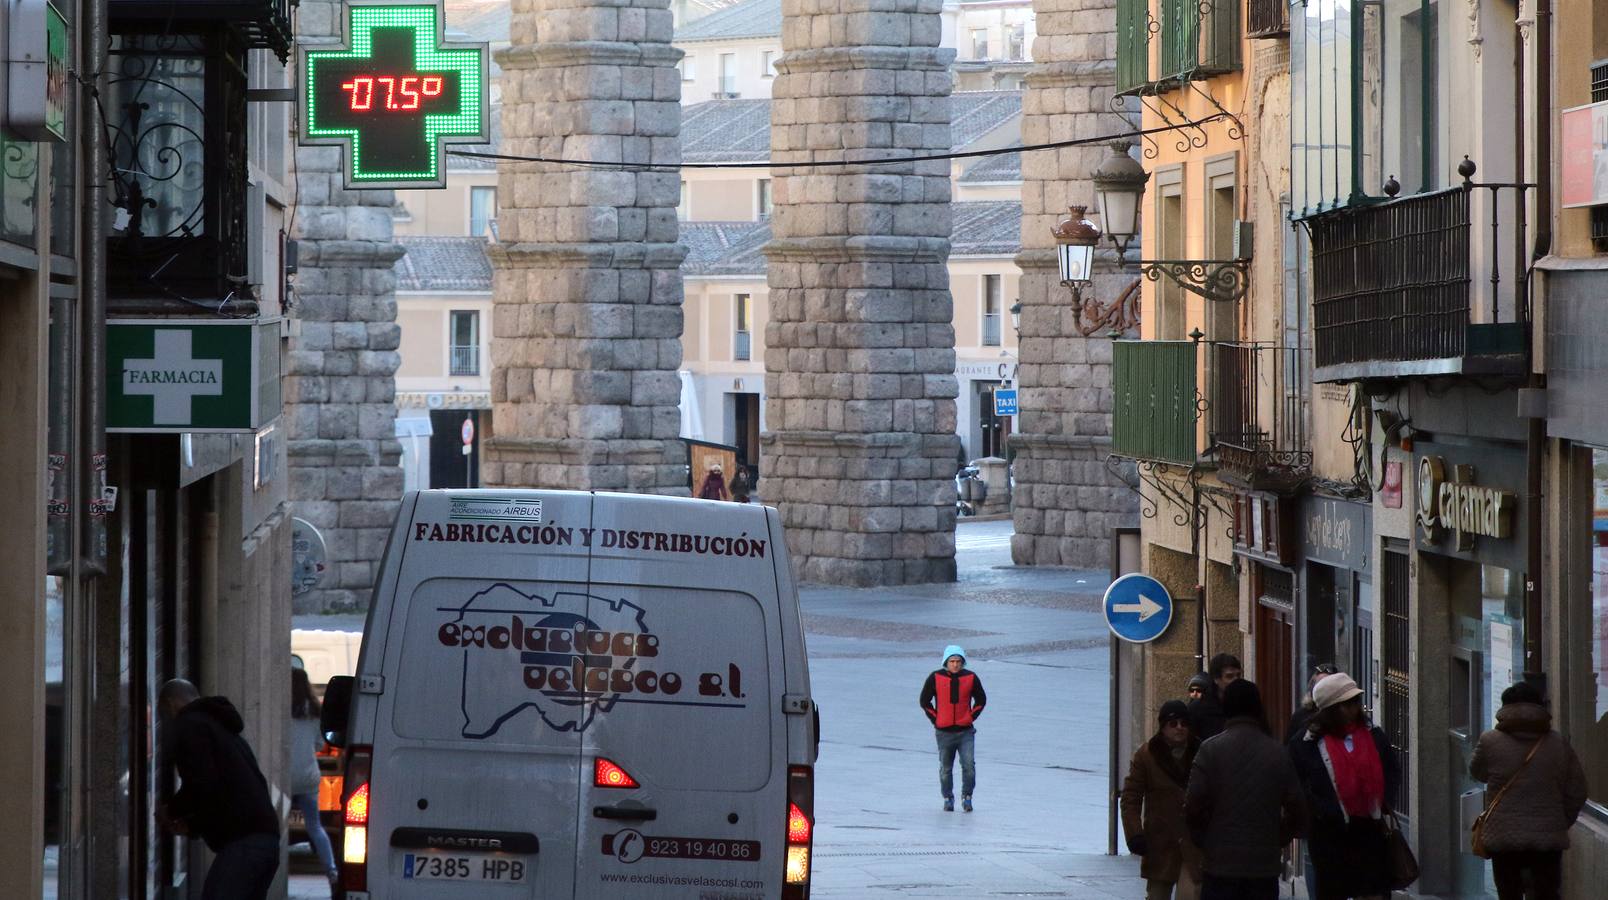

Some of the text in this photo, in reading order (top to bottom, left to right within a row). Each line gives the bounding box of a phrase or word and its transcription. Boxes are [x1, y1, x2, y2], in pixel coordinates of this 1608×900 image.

[129, 370, 217, 384] FARMACIA
[394, 393, 492, 409] WHOPPE
[997, 398, 1016, 407] TAXI
[503, 507, 541, 516] AIRBUS
[1438, 464, 1504, 552] cajamar
[415, 520, 767, 559] FABRICACIÓN Y DISTRIBUCIÓN
[438, 614, 659, 658] exclusivas
[427, 836, 502, 848] MASTER
[650, 839, 750, 858] 923 19 40 86
[415, 856, 524, 881] 7385 HPB
[600, 872, 764, 889] www.exclusivasvelascosl.com
